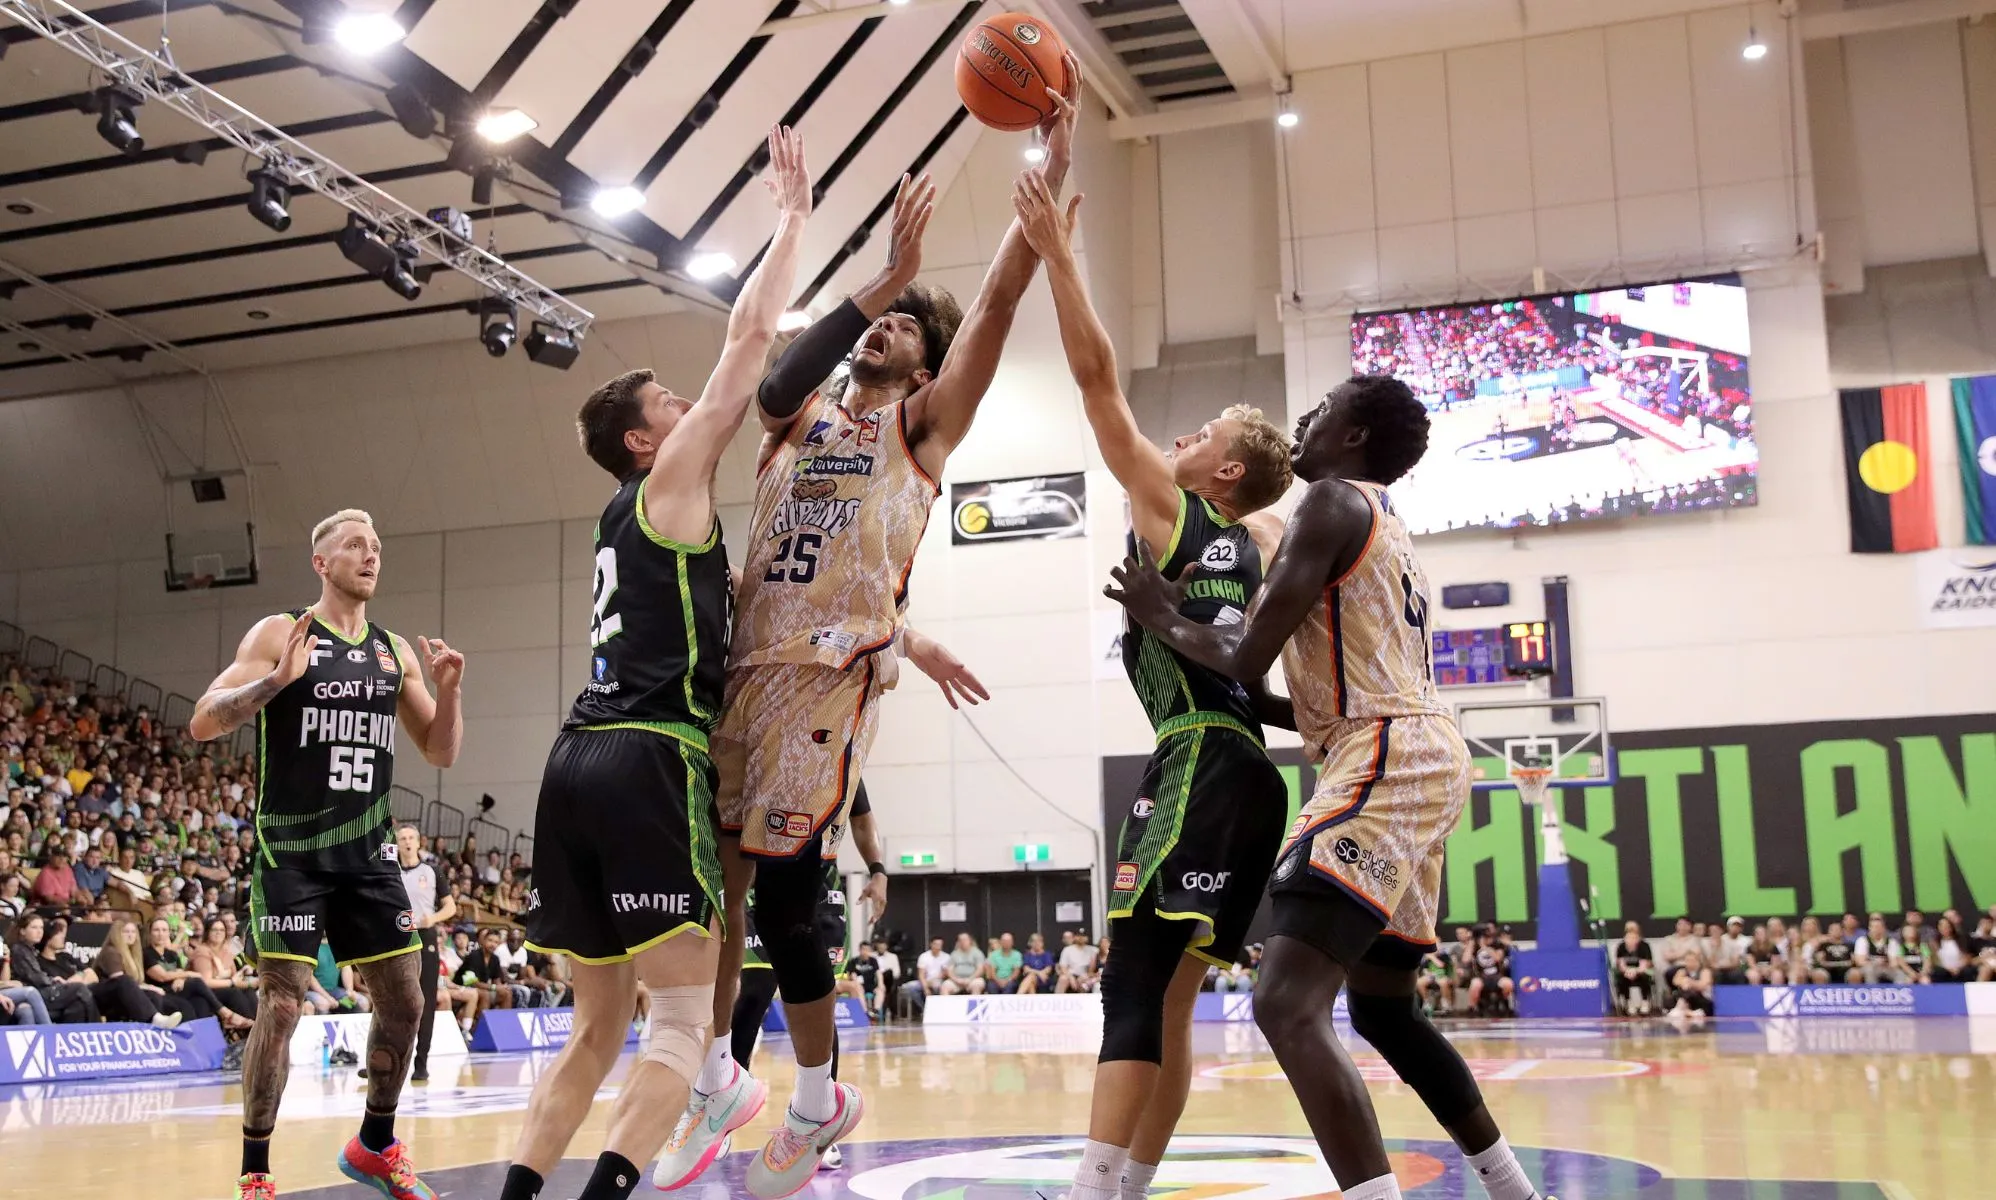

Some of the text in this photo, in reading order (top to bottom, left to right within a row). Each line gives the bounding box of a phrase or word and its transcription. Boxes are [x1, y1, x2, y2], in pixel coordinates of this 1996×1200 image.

[969, 31, 1033, 88] SPALDING
[764, 533, 822, 583] 25
[1207, 545, 1233, 562] a2
[1521, 635, 1545, 662] 17
[313, 680, 363, 699] GOAT
[299, 707, 397, 754] PHOENIX
[328, 746, 376, 792] 55
[1357, 860, 1398, 889] pilates
[1361, 849, 1398, 876] studio
[1181, 871, 1231, 893] GOAT
[612, 893, 690, 914] TRADIE
[259, 914, 316, 932] TRADIE
[65, 941, 103, 963] Ringw
[1799, 987, 1914, 1005] ASHFORDS
[55, 1029, 177, 1058] ASHFORDS
[58, 1057, 181, 1073] FOR YOUR FINANCIAL FREEDOM
